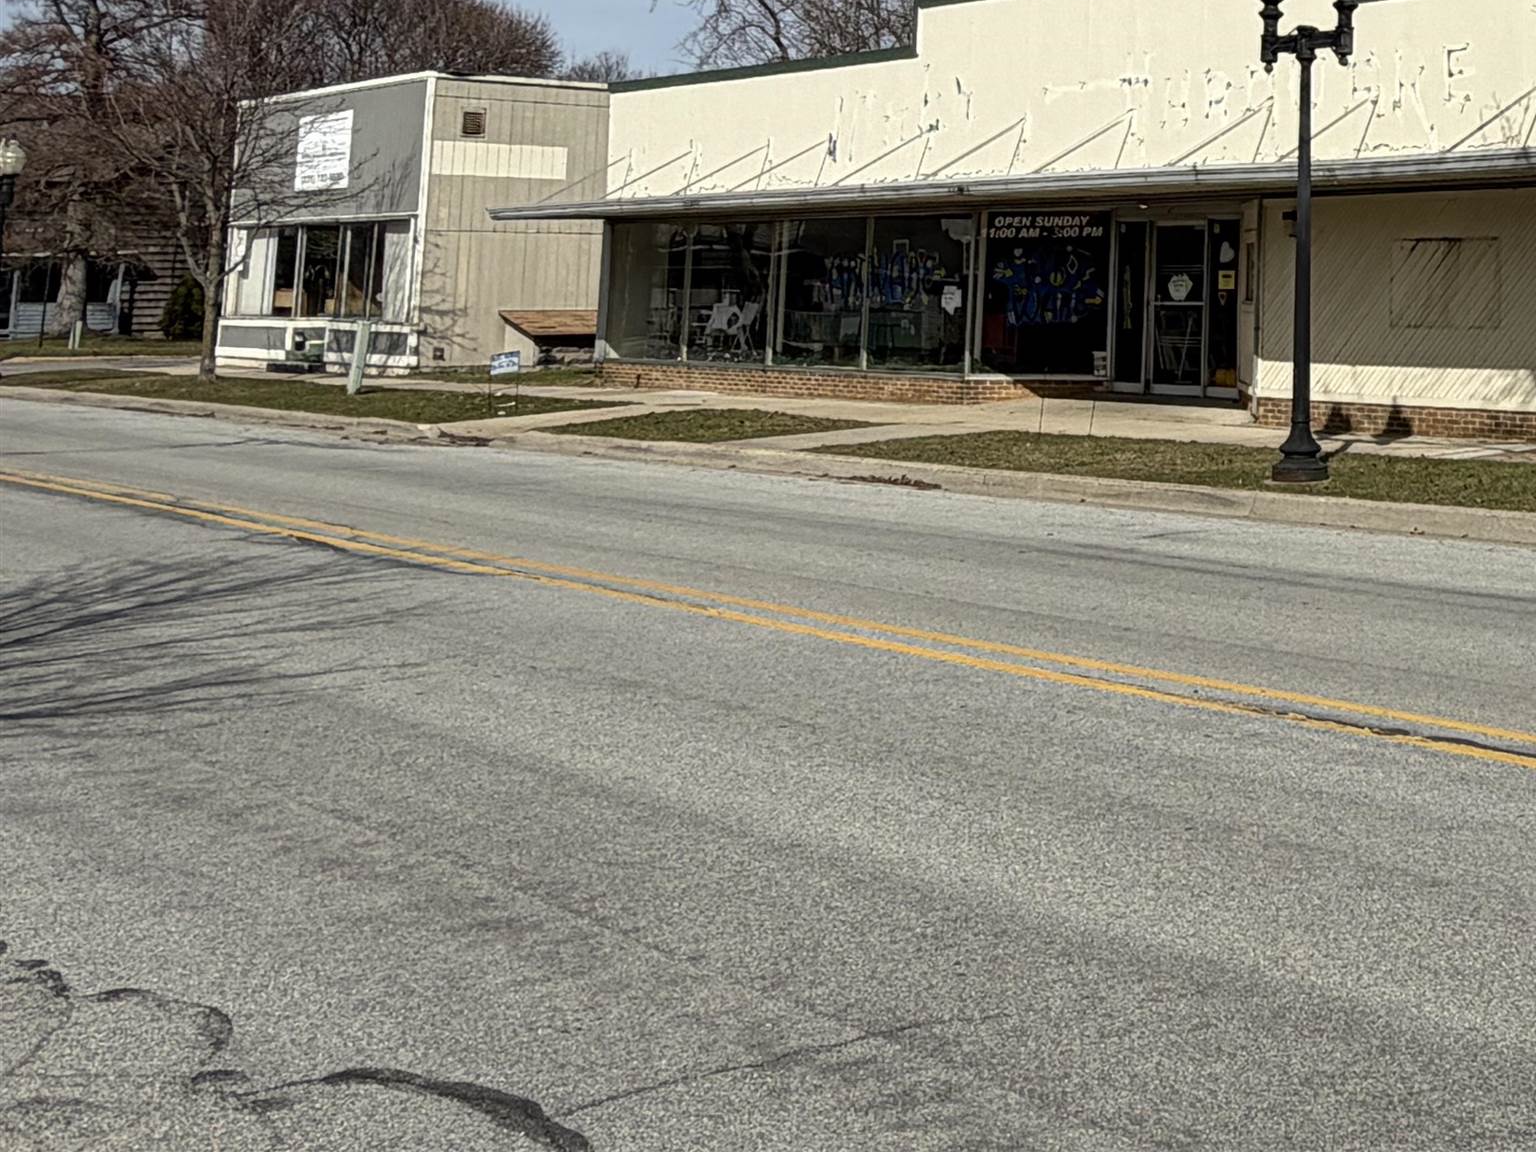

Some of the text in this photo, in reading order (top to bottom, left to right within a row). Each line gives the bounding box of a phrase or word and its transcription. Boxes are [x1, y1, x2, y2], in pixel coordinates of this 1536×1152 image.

[994, 215, 1090, 227] OPEN SUNDAY
[1018, 227, 1040, 238] AM
[1082, 226, 1103, 237] PM
